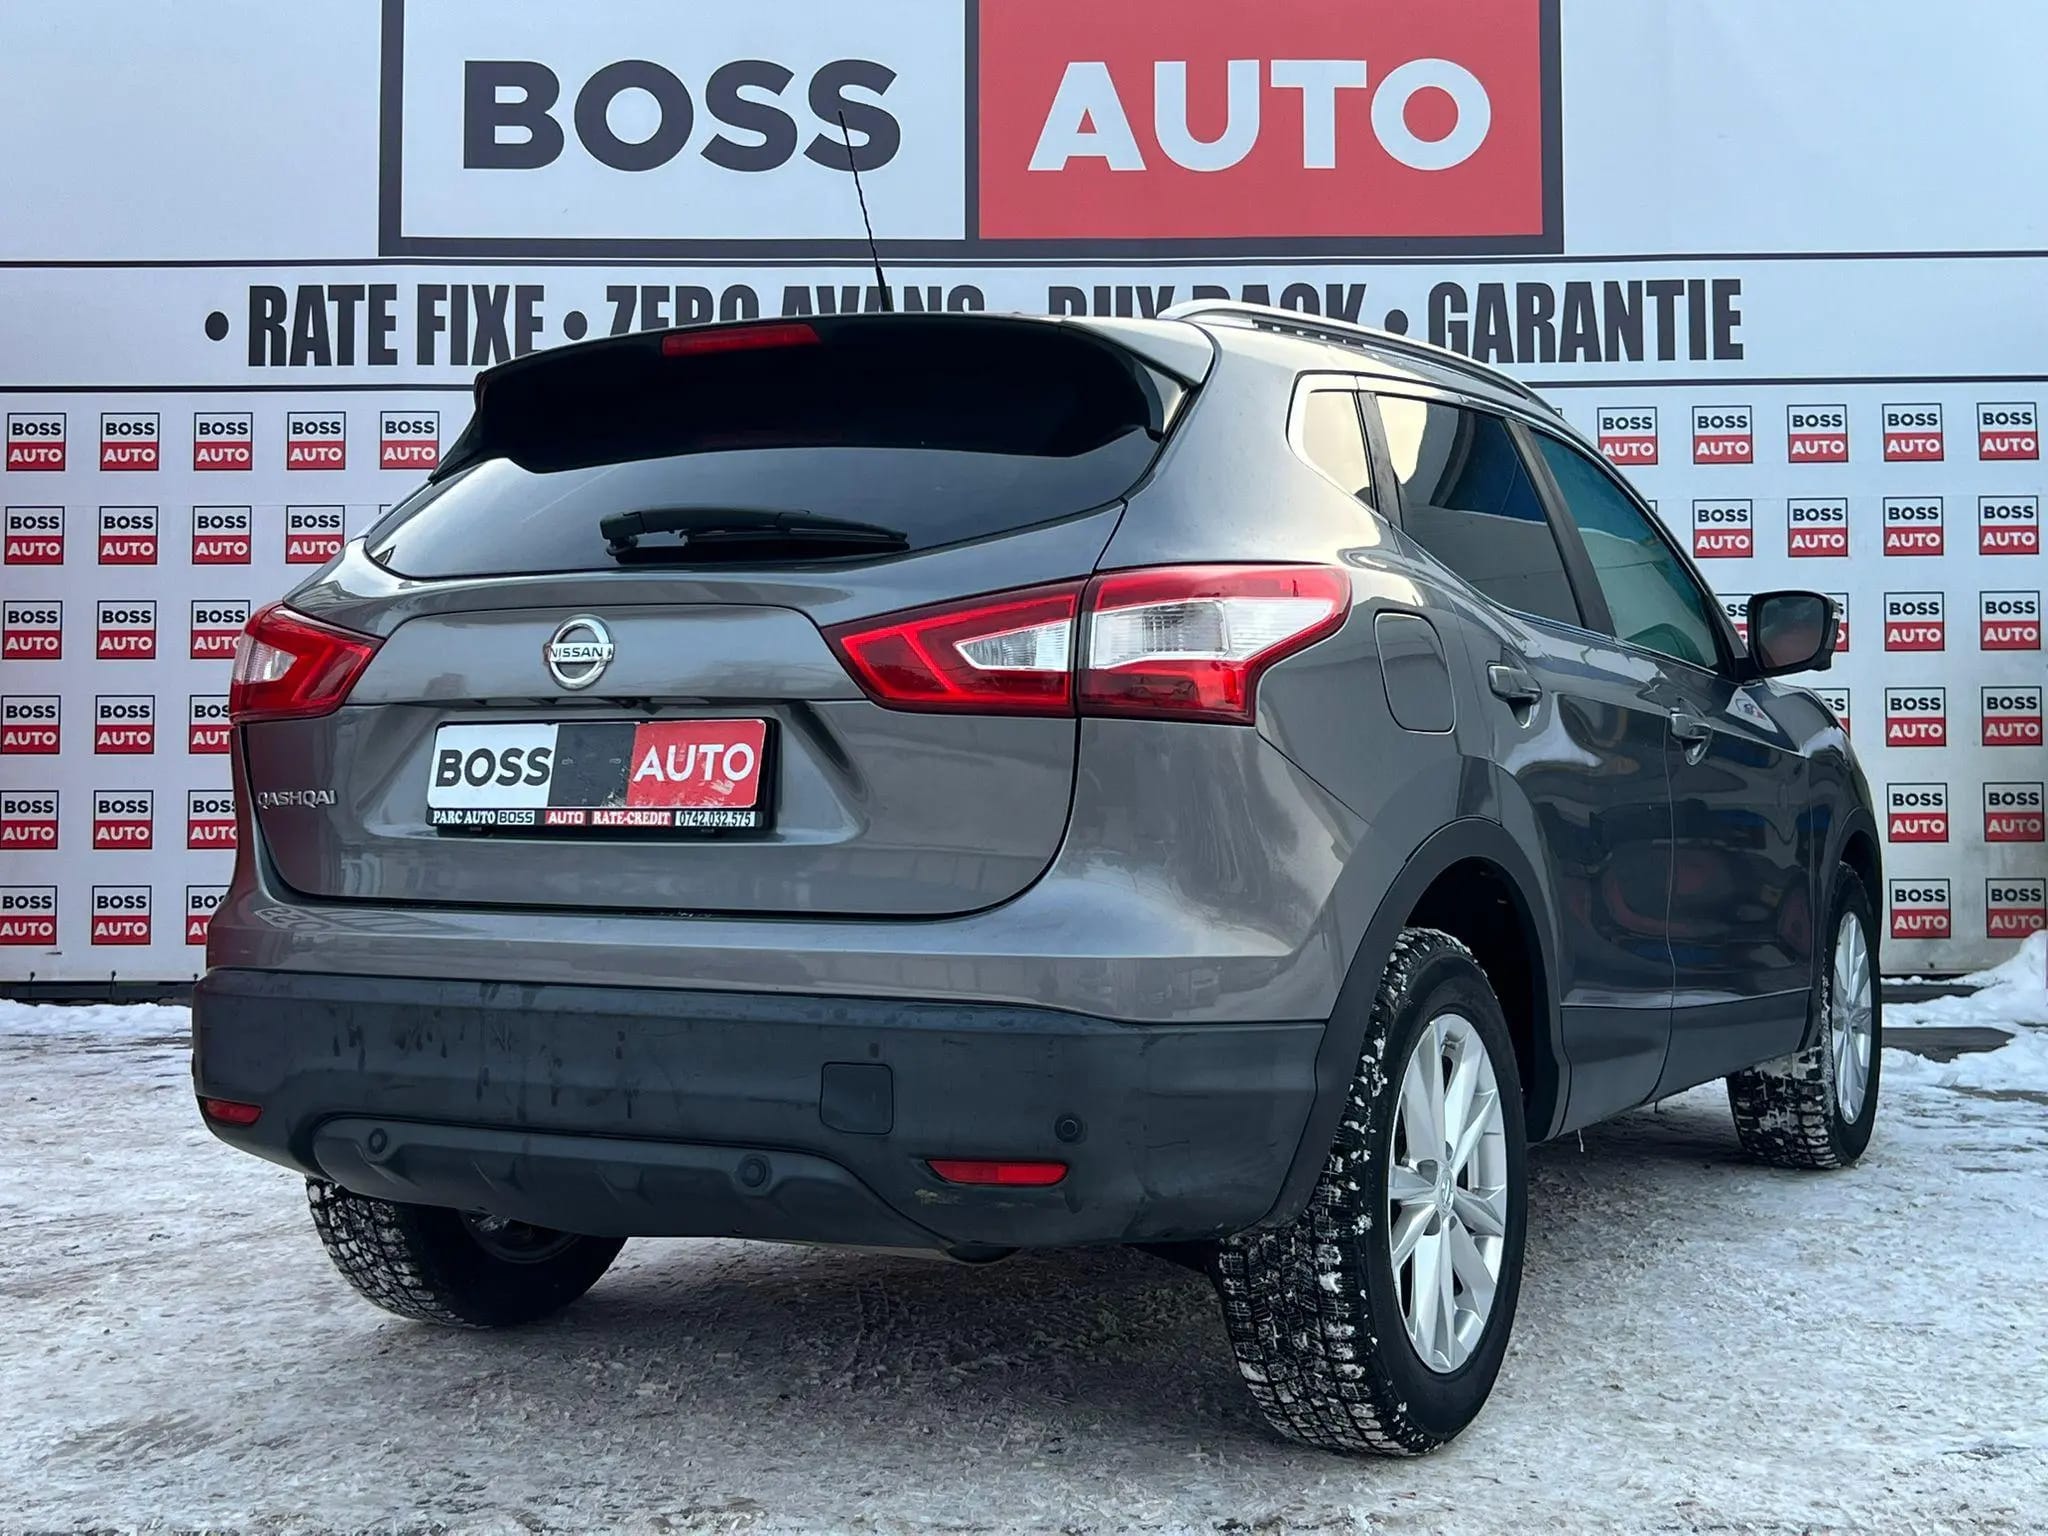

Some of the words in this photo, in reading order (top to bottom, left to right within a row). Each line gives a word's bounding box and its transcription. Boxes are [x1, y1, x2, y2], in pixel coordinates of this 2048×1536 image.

[464, 59, 901, 171] BOSS
[1028, 58, 1491, 172] AUTO
[249, 285, 397, 366] RATE
[417, 284, 544, 365] FIXE
[1428, 278, 1744, 363] GARANTIE
[1603, 417, 1652, 430] BOSS
[1698, 416, 1747, 428] BOSS
[1793, 414, 1842, 427] BOSS
[1888, 413, 1937, 426] BOSS
[1983, 412, 2032, 425] BOSS
[12, 423, 61, 435] BOSS
[106, 423, 154, 435] BOSS
[199, 422, 248, 435] BOSS
[293, 422, 341, 434] BOSS
[385, 421, 434, 433] BOSS
[1602, 443, 1654, 456] AUTO
[1696, 442, 1749, 455] AUTO
[1792, 441, 1844, 454] AUTO
[1887, 439, 1940, 452] AUTO
[1982, 438, 2035, 451] AUTO
[9, 449, 62, 462] AUTO
[104, 449, 155, 461] AUTO
[197, 448, 249, 461] AUTO
[290, 448, 342, 461] AUTO
[384, 447, 435, 460] AUTO
[1698, 509, 1747, 522] BOSS
[1793, 508, 1843, 521] BOSS
[1889, 507, 1938, 520] BOSS
[1984, 506, 2033, 519] BOSS
[11, 516, 59, 529] BOSS
[104, 516, 153, 529] BOSS
[198, 516, 246, 528] BOSS
[291, 515, 340, 528] BOSS
[1697, 536, 1749, 549] AUTO
[1792, 534, 1844, 548] AUTO
[1887, 533, 1940, 547] AUTO
[1983, 532, 2035, 545] AUTO
[8, 543, 60, 555] AUTO
[102, 543, 154, 555] AUTO
[196, 542, 247, 555] AUTO
[289, 541, 342, 555] AUTO
[1890, 602, 1939, 615] BOSS
[1986, 601, 2035, 614] BOSS
[8, 611, 57, 623] BOSS
[102, 611, 151, 623] BOSS
[196, 610, 245, 623] BOSS
[1888, 629, 1941, 642] AUTO
[1984, 628, 2037, 641] AUTO
[6, 637, 58, 650] AUTO
[100, 637, 152, 650] AUTO
[550, 647, 603, 658] NISSAN
[1891, 698, 1941, 710] BOSS
[1987, 697, 2037, 709] BOSS
[6, 705, 56, 718] BOSS
[101, 705, 150, 718] BOSS
[195, 705, 229, 718] BOS
[1889, 724, 1942, 737] AUTO
[1986, 723, 2039, 736] AUTO
[4, 732, 56, 745] AUTO
[98, 732, 151, 745] AUTO
[192, 731, 229, 744] AUT
[435, 747, 553, 788] BOSS
[633, 742, 755, 783] AUTO
[258, 790, 336, 809] QASHQAI
[1893, 793, 1943, 806] BOSS
[1989, 792, 2039, 805] BOSS
[5, 801, 53, 813] BOSS
[99, 800, 148, 813] BOSS
[433, 811, 463, 824] PARC
[464, 811, 496, 824] AUTO
[499, 812, 533, 824] BOSS
[548, 811, 584, 824] AUTO
[592, 811, 671, 825] RATE-CREDIT
[1891, 820, 1945, 833] AUTO
[1988, 819, 2040, 832] AUTO
[2, 827, 54, 840] AUTO
[96, 827, 149, 840] AUTO
[97, 896, 146, 908] BOSS
[1895, 889, 1945, 902] BOSS
[1992, 889, 2041, 902] BOSS
[3, 896, 52, 909] BOSS
[95, 922, 147, 935] AUTO
[1894, 916, 1947, 929] AUTO
[1990, 916, 2043, 930] AUTO
[0, 923, 53, 936] AUTO
